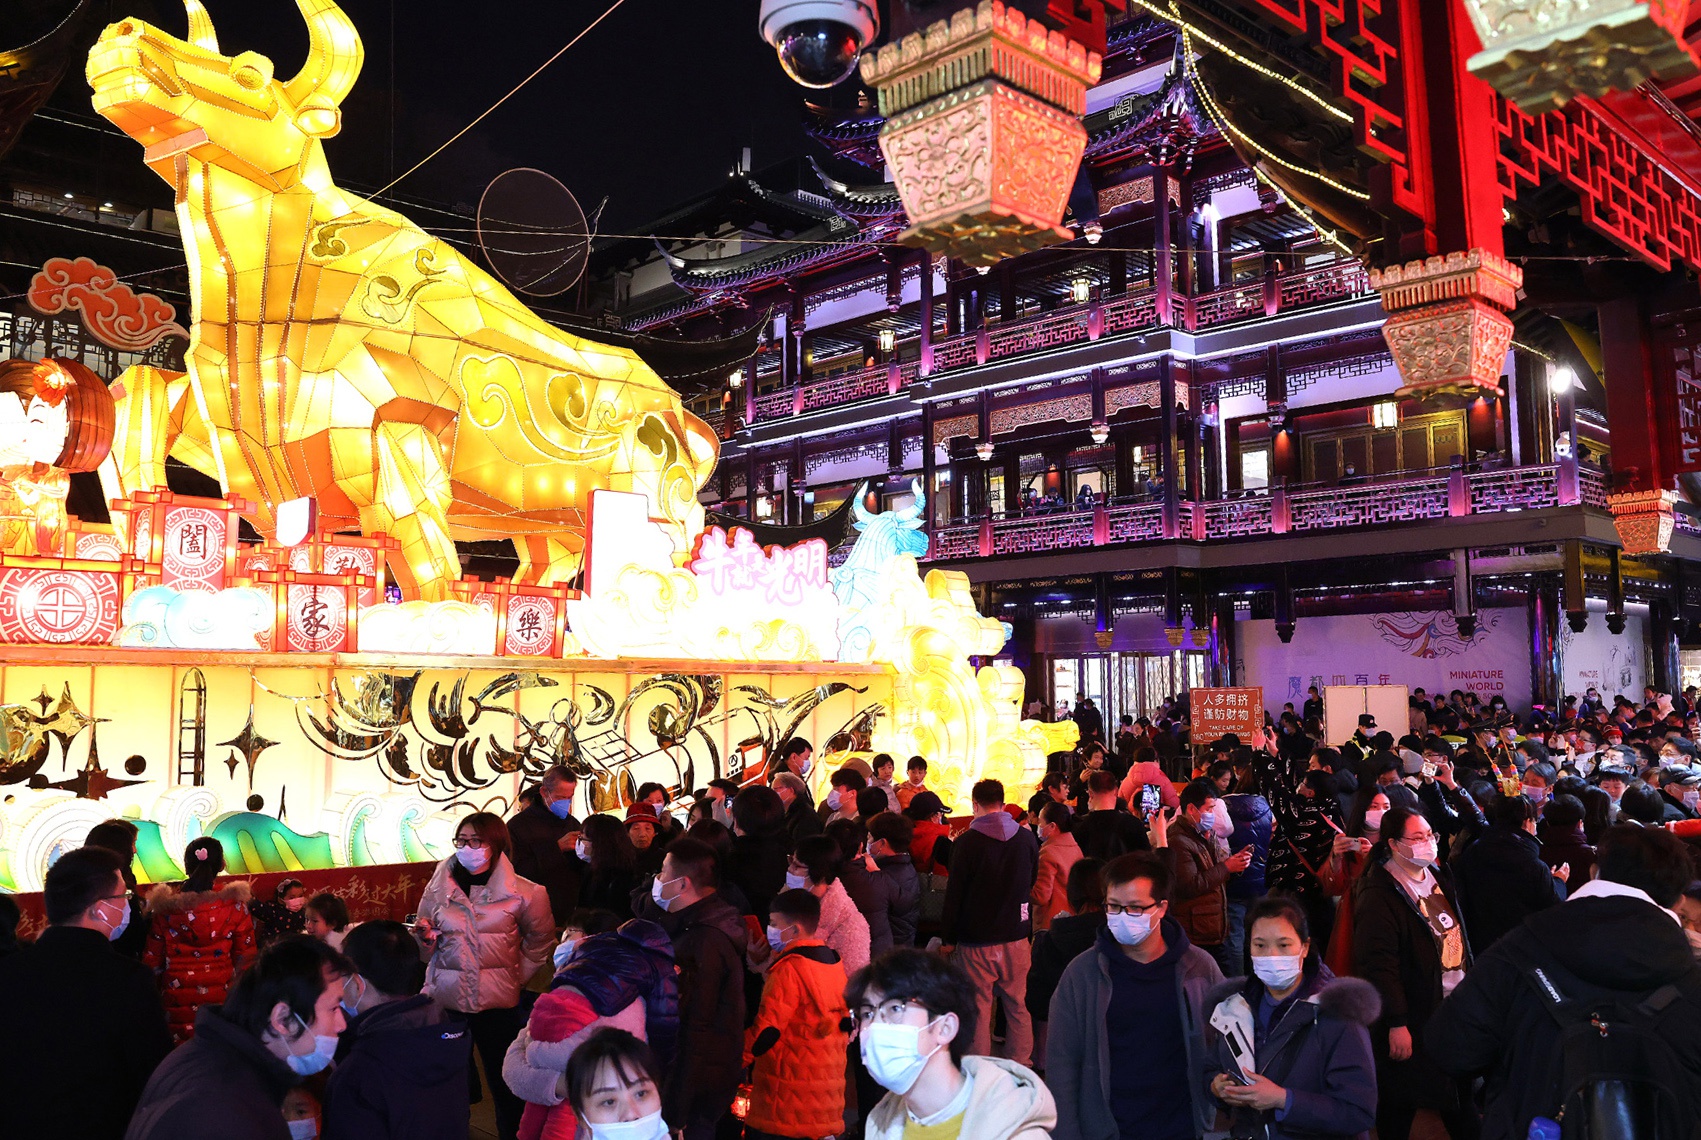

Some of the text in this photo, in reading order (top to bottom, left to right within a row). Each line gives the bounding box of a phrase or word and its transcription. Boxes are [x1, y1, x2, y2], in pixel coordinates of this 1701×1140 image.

[301, 597, 330, 638] 家
[516, 608, 542, 641] 樂
[1450, 670, 1503, 679] MINIATURE
[1466, 682, 1504, 690] WORLD
[1203, 694, 1248, 706] 人多拥挤
[1203, 708, 1248, 720] 谨防财物
